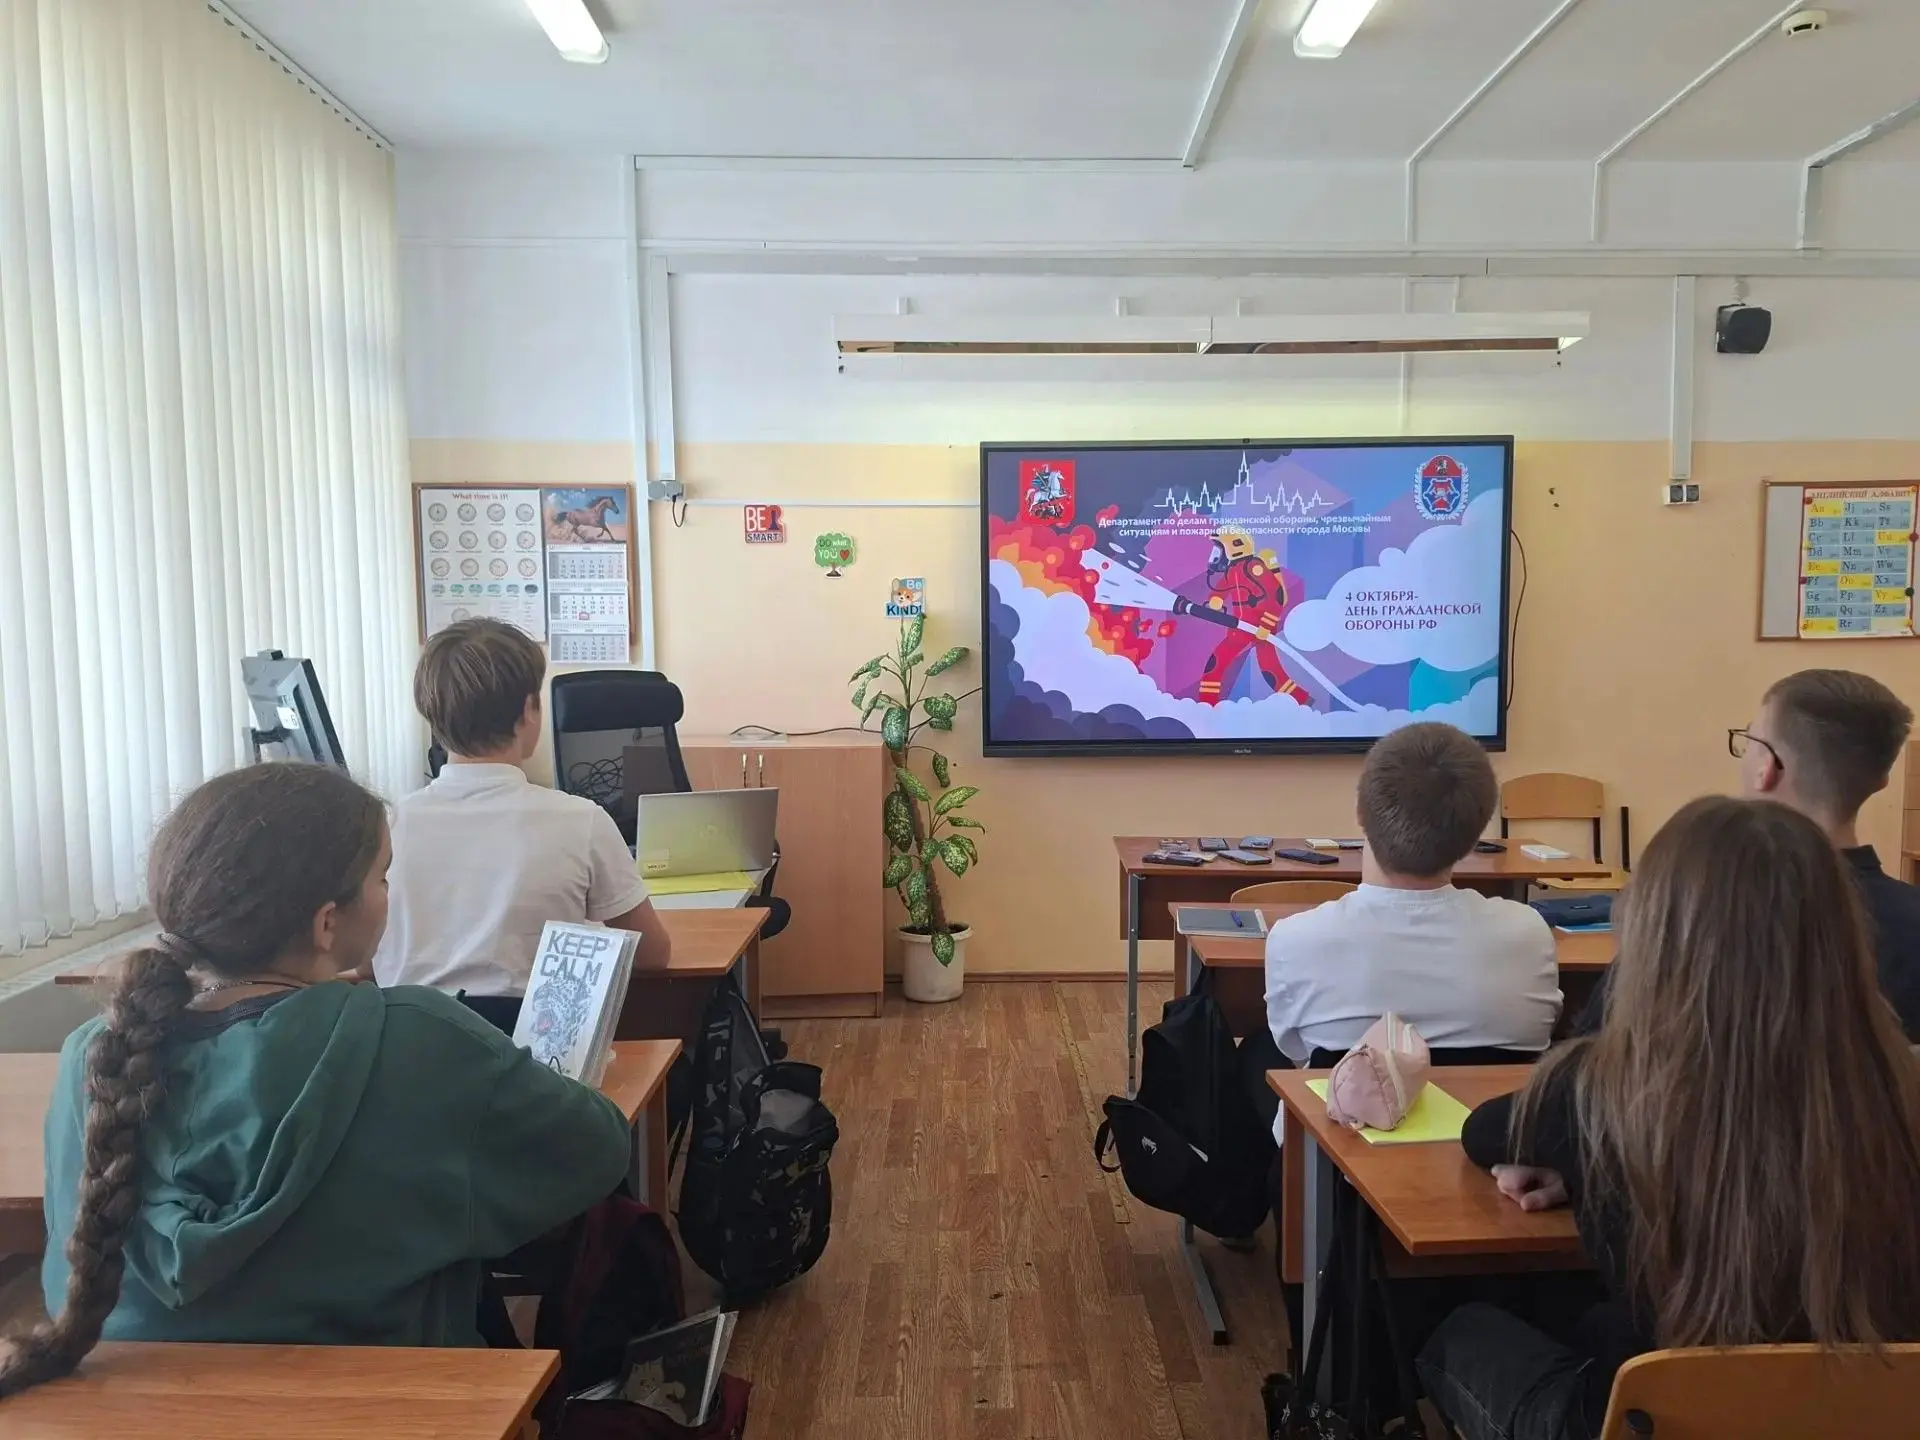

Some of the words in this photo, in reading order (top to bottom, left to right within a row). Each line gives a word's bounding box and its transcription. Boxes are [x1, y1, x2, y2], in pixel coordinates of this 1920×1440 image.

[745, 506, 766, 531] BE
[1098, 517, 1161, 528] Департамент
[1177, 518, 1207, 526] делам
[1209, 515, 1270, 526] гражданской
[1273, 515, 1319, 525] обороны,
[1320, 514, 1391, 524] чрезвычайным
[1119, 528, 1169, 537] ситуациям
[1180, 527, 1228, 536] пожарной
[1229, 525, 1295, 535] безопасности
[1297, 526, 1330, 536] города
[1332, 524, 1371, 533] Москвы
[747, 533, 779, 542] SMART
[906, 579, 922, 590] Be
[1345, 592, 1352, 601] 4
[1356, 591, 1419, 601] ОКТЯБРЯ-
[1345, 605, 1378, 616] ДЕНЬ
[1382, 602, 1482, 616] ГРАЖДАНСКОЙ
[1345, 619, 1414, 631] ОБОРОНЫ
[1418, 618, 1438, 630] РФ
[546, 930, 610, 959] KEEP
[540, 954, 603, 986] CALM
